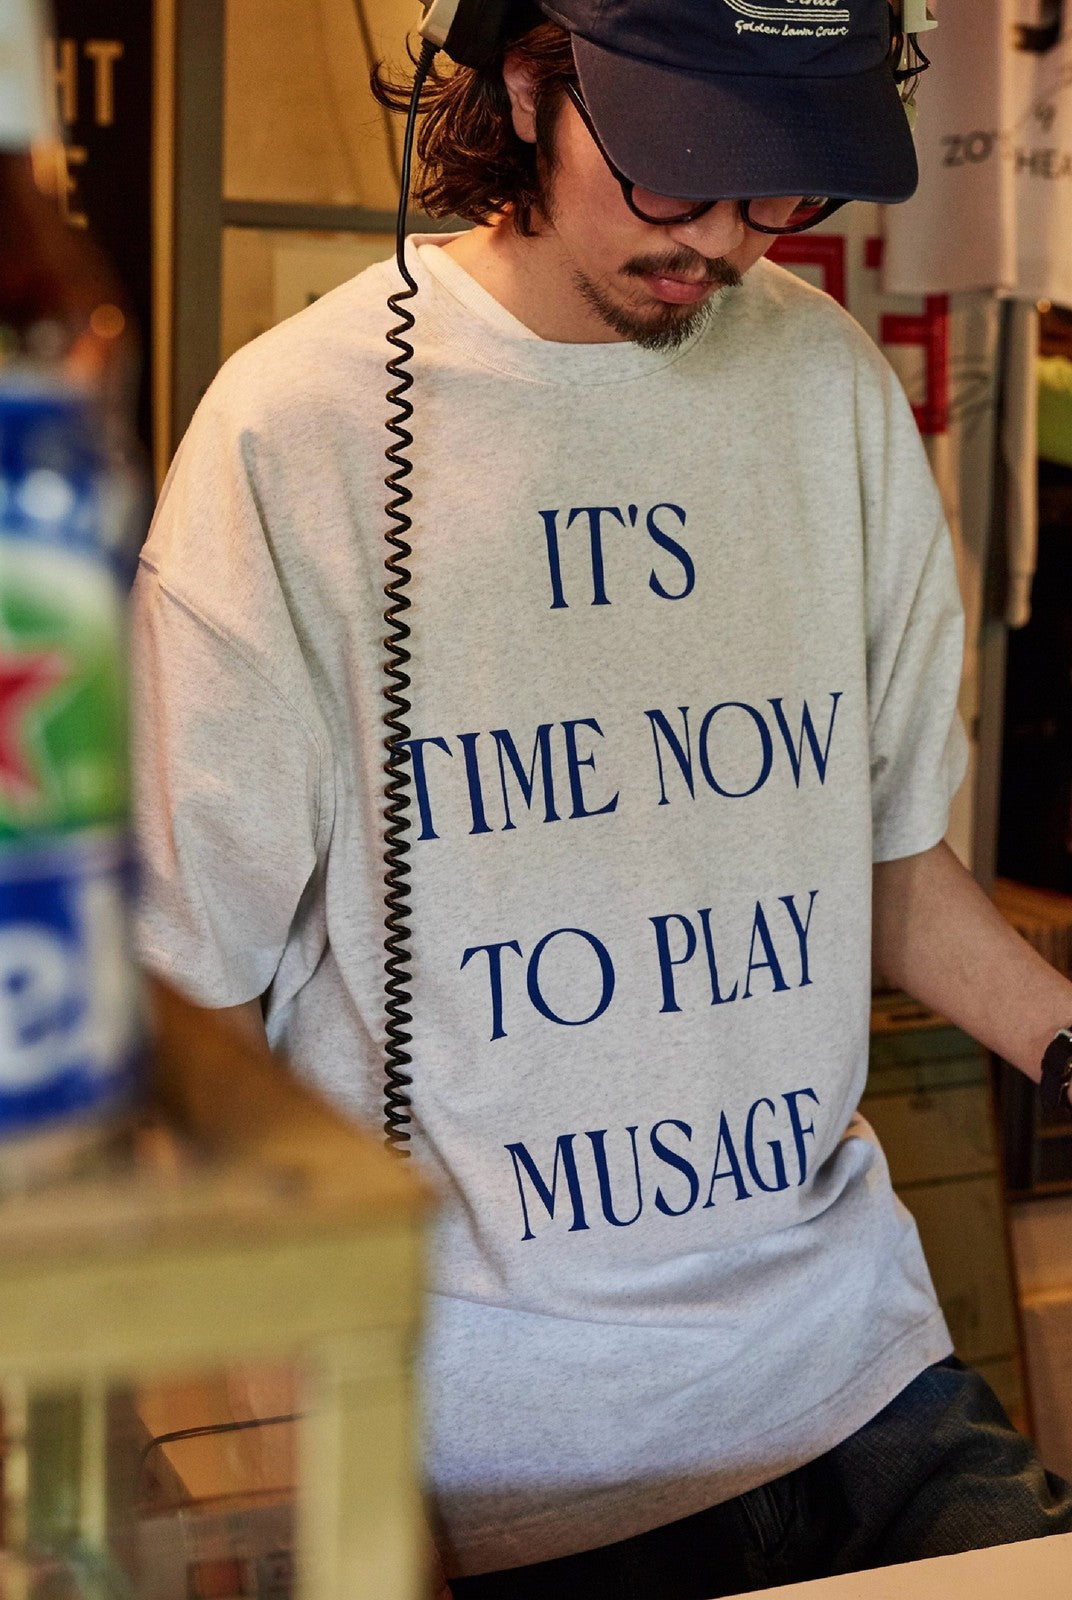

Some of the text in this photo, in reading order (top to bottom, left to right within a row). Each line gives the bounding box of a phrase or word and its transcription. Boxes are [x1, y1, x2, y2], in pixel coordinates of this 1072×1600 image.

[735, 20, 849, 37] Golden Lawn Court
[538, 503, 695, 609] IT'S
[389, 692, 843, 841] TIME NOW
[460, 890, 819, 1041] TO PLAY
